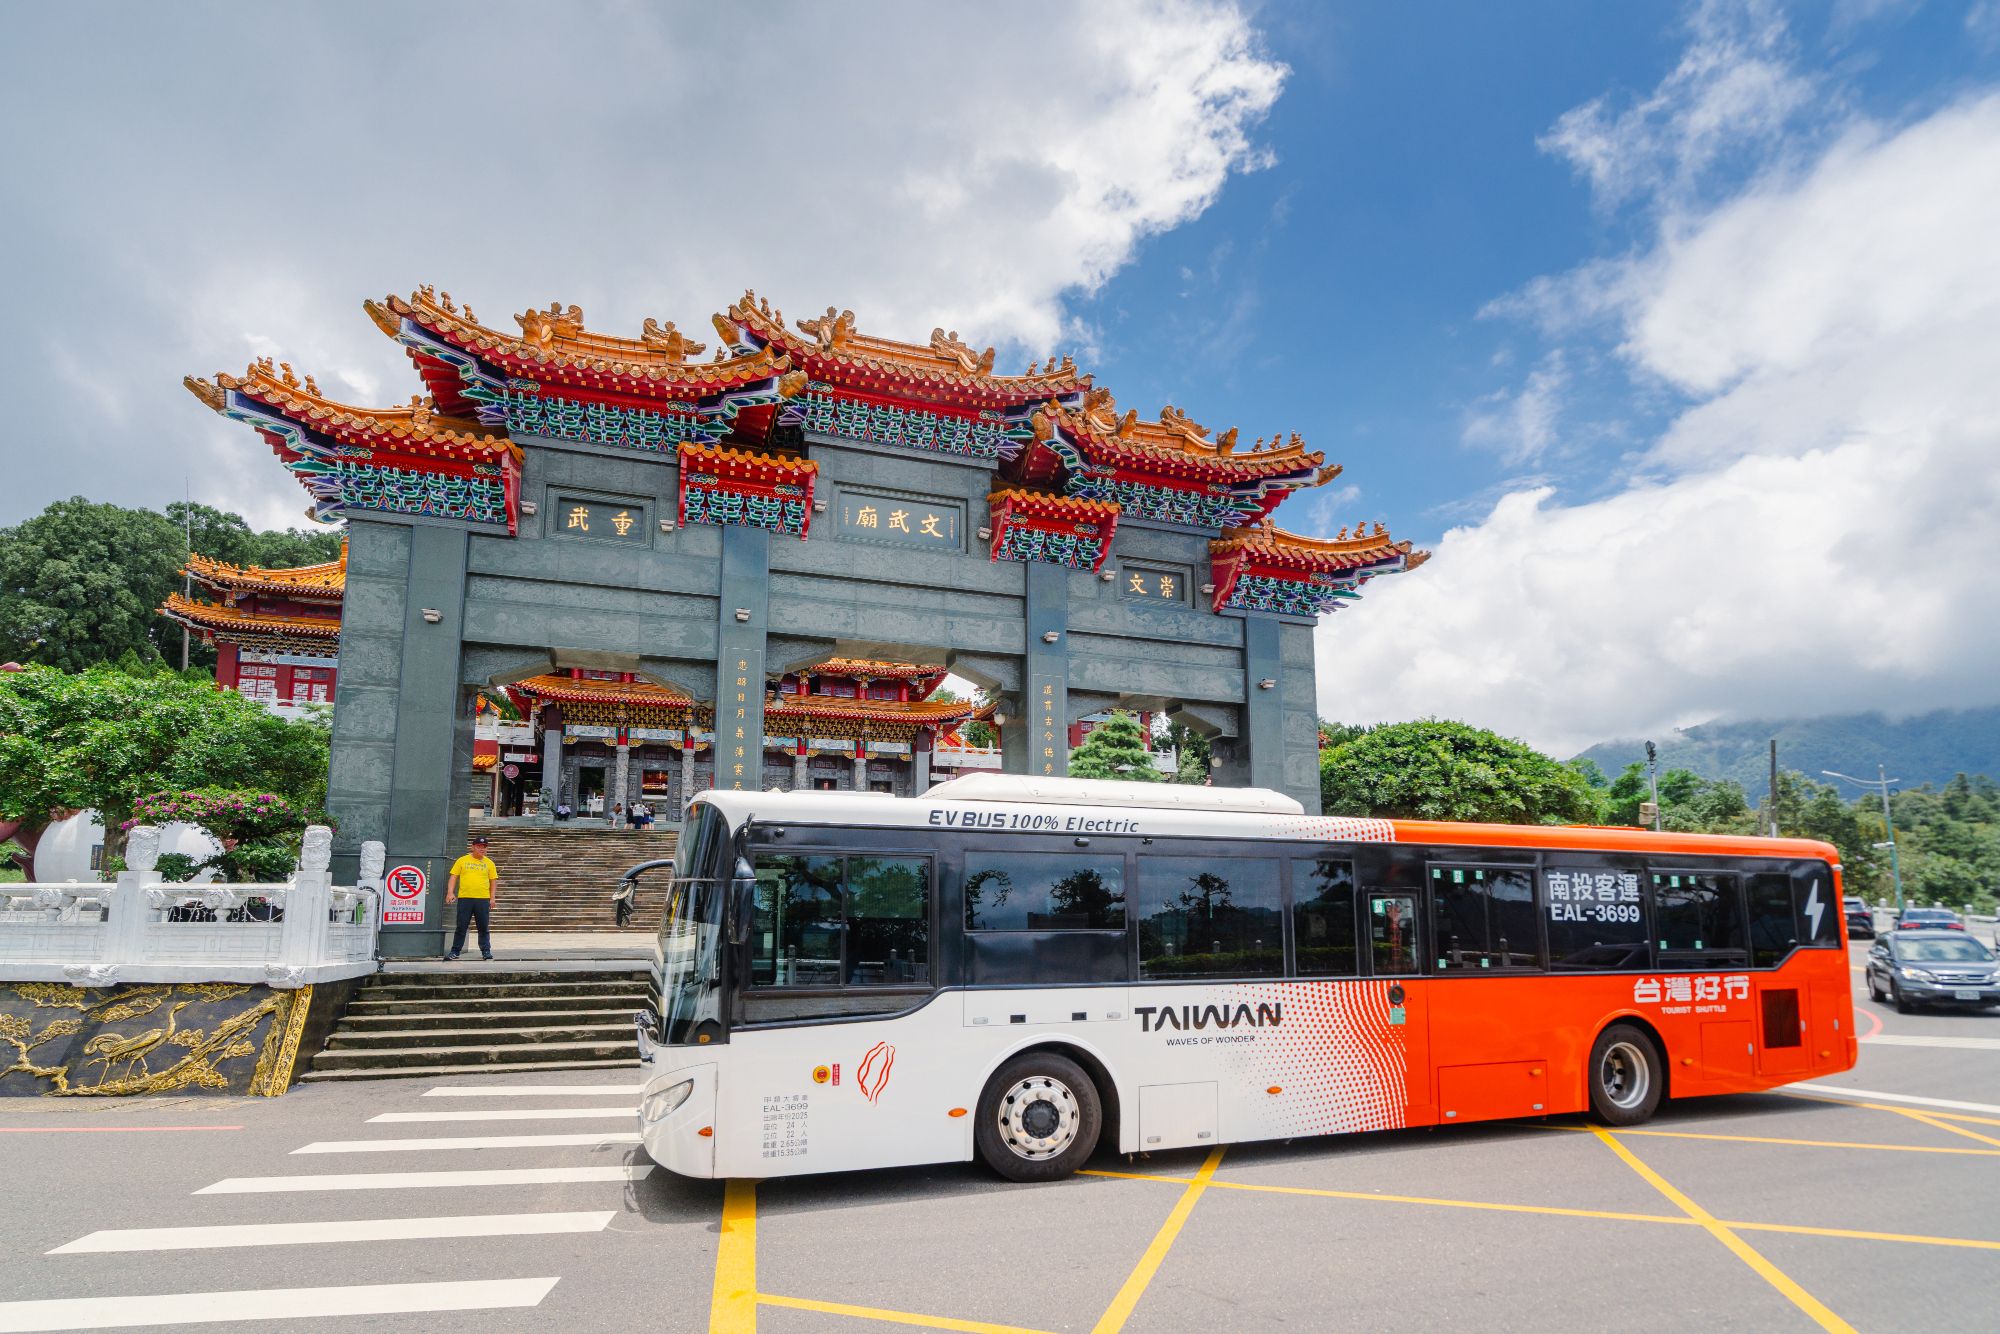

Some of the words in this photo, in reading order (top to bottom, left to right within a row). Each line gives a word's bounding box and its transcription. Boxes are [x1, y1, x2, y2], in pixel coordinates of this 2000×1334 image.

[928, 809, 958, 826] EV
[961, 811, 1007, 828] BUS
[1009, 813, 1059, 830] 100%
[1065, 816, 1140, 833] Electric
[1547, 872, 1640, 902] 南投客運
[1550, 903, 1640, 922] EAL-3699
[1633, 975, 1750, 1004] 台灣好行
[1134, 1002, 1281, 1032] TAIWAN
[1661, 1006, 1692, 1014] TOURIST
[1695, 1005, 1727, 1013] SHUTTLE
[1166, 1037, 1199, 1046] WAVES
[1200, 1036, 1213, 1045] OF
[1215, 1035, 1256, 1044] WONDER
[763, 1103, 808, 1112] EAL-3699
[786, 1121, 795, 1129] 24
[786, 1130, 795, 1139] 22
